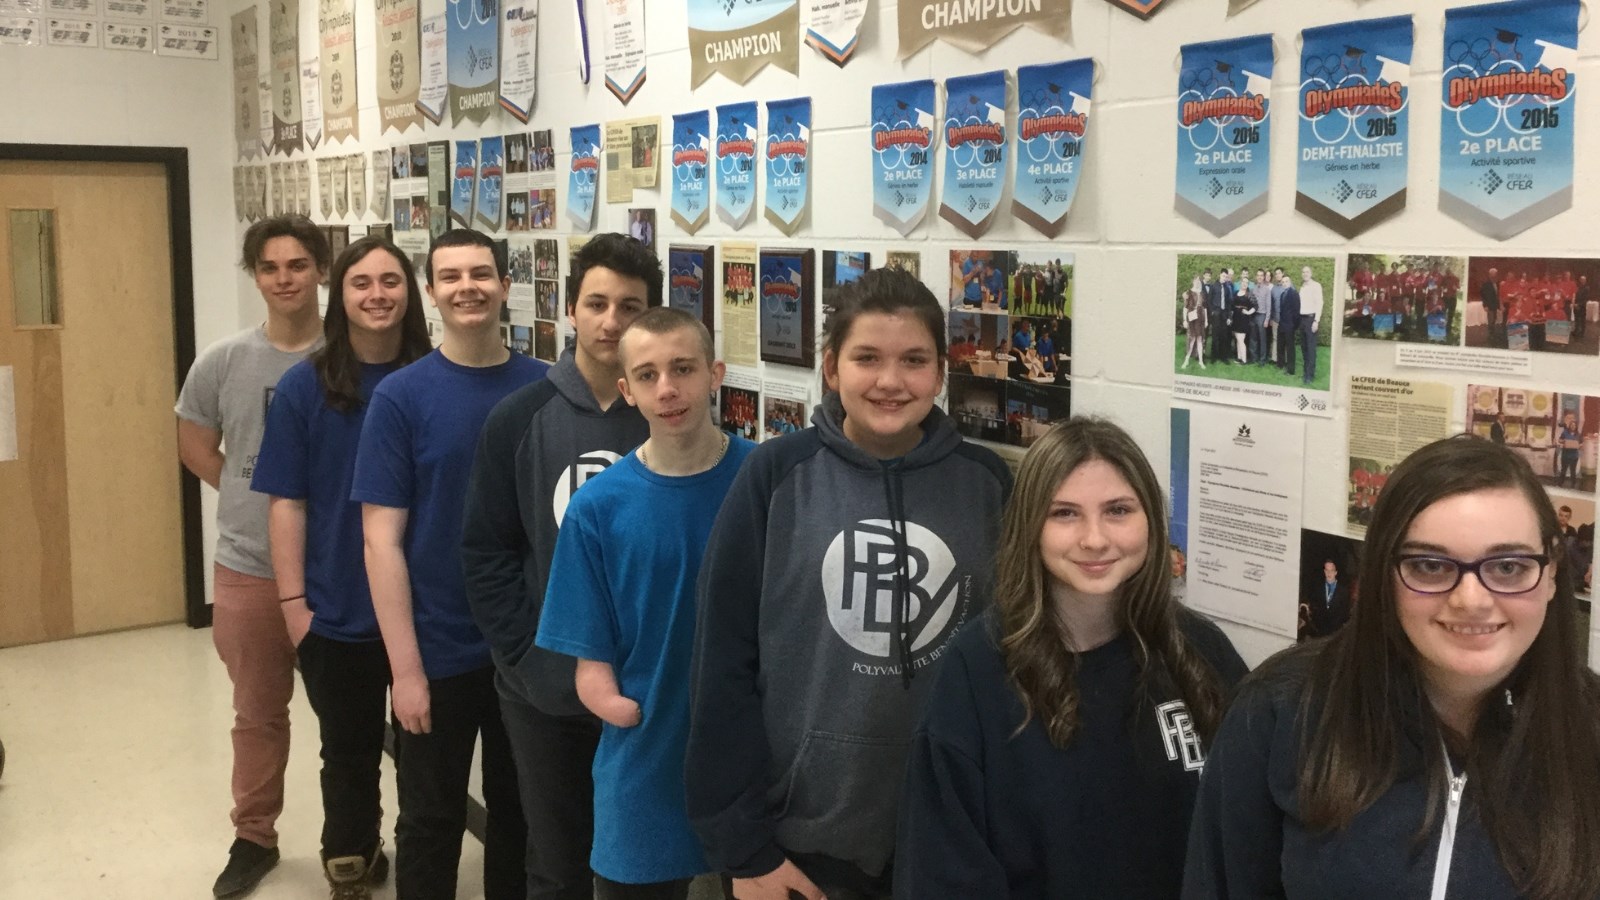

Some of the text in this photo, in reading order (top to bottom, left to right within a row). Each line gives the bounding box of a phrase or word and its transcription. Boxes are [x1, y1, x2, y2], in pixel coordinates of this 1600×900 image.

[921, 0, 1040, 30] CHAMPION
[705, 31, 782, 63] CHAMPION
[459, 91, 497, 111] CHAMPION
[385, 103, 417, 120] CHAMPION
[1520, 107, 1559, 131] 2015
[1232, 125, 1260, 145] 2015
[1366, 117, 1396, 139] 2015
[1062, 142, 1081, 159] 2014
[1302, 142, 1403, 161] DEMI-FINALISTE
[1459, 135, 1542, 155] 2e PLACE
[1194, 149, 1252, 165] 2e PLACE
[1470, 156, 1536, 168] Activité sportive
[969, 168, 996, 180] PLACE
[1027, 161, 1073, 176] 4e PLACE
[1325, 162, 1349, 172] Génies
[1360, 161, 1380, 171] herbe
[732, 174, 750, 184] PLACE
[783, 176, 801, 187] PLACE
[884, 169, 923, 181] 2e PLACE
[688, 181, 703, 190] PLACE
[1351, 384, 1374, 392] revient
[1375, 386, 1400, 394] couvert
[1400, 387, 1414, 395] d'or
[1360, 376, 1376, 385] CFER
[1387, 379, 1410, 387] Beauce
